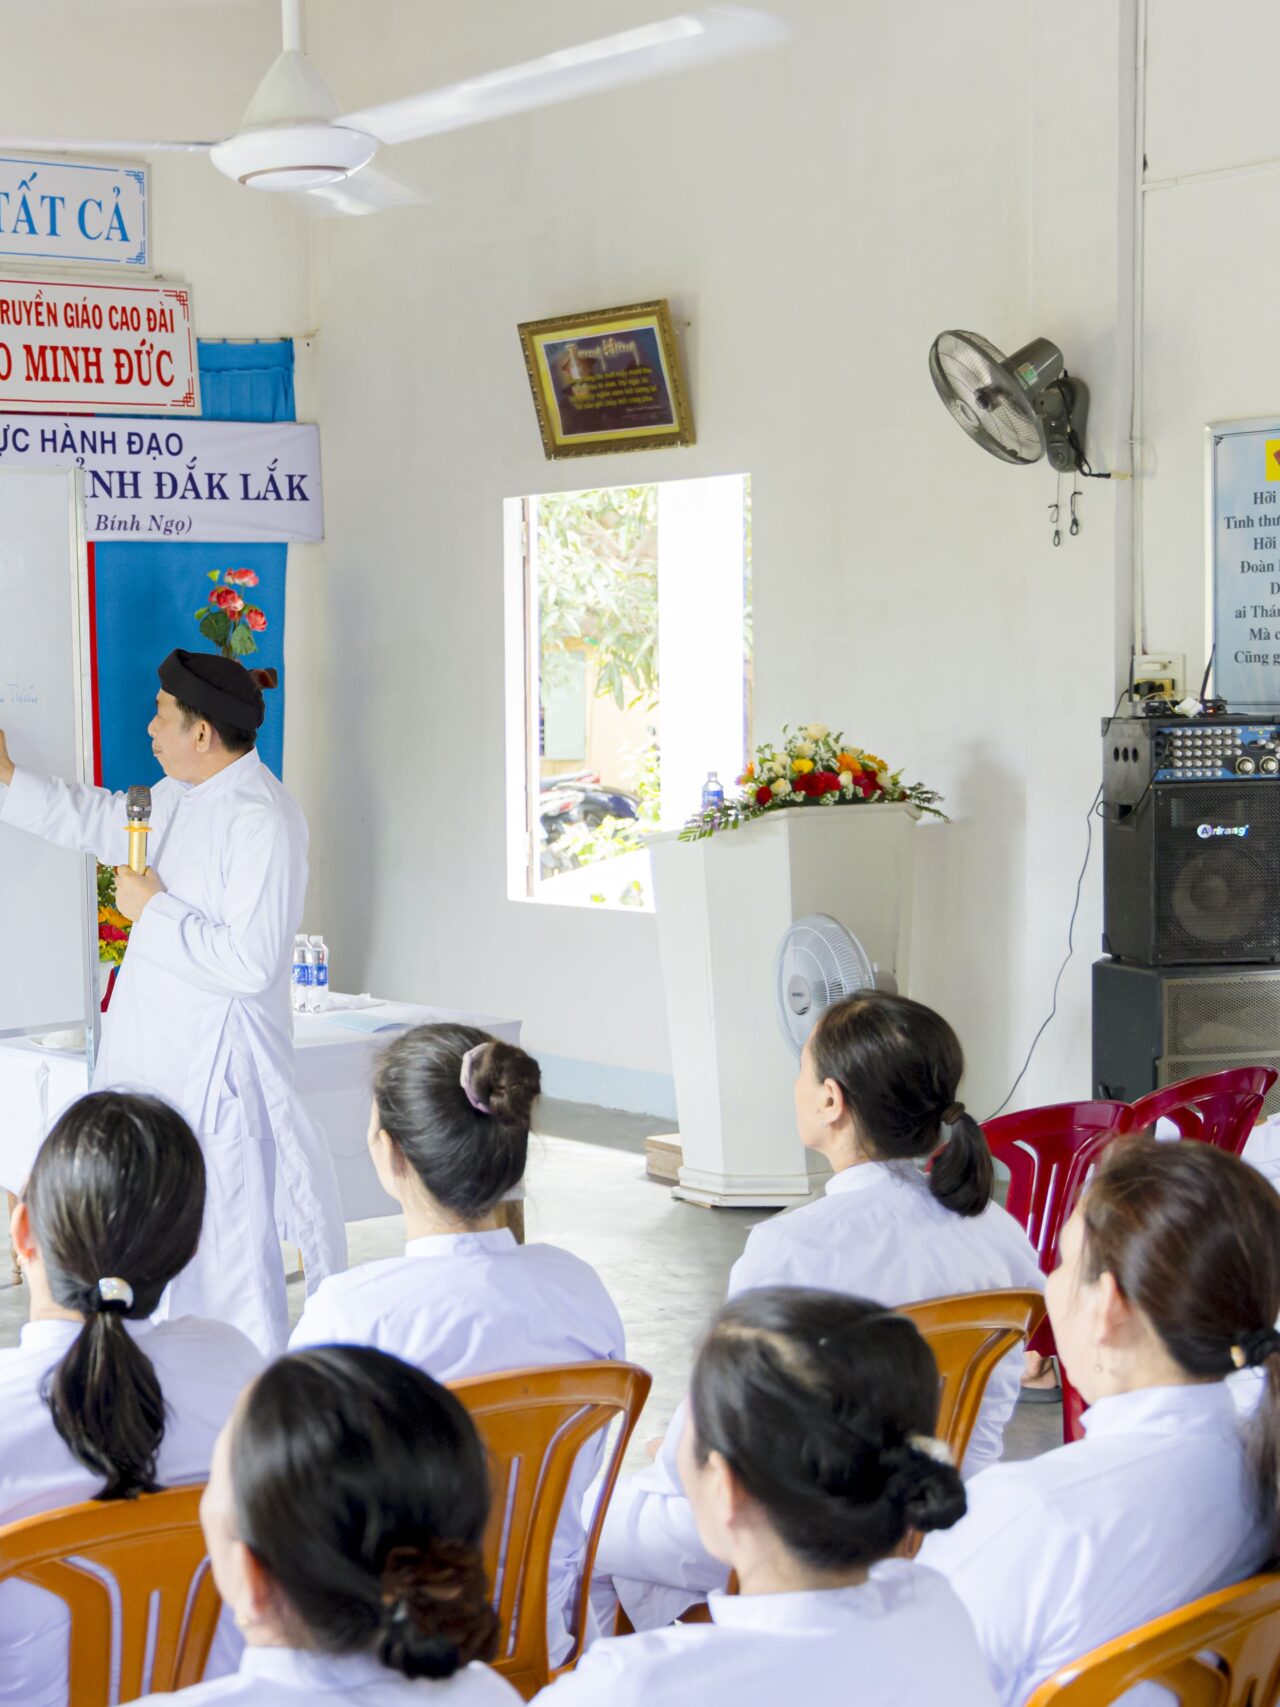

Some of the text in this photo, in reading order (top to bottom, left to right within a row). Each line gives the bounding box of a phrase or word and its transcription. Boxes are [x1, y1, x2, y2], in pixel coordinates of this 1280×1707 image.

[77, 186, 131, 242] CẢ
[63, 297, 103, 330] GIÁO
[108, 305, 141, 332] CAO
[146, 301, 175, 334] ĐÀI
[23, 344, 105, 384] MINH
[113, 338, 175, 387] ĐỨC
[40, 426, 117, 456] HÀNH
[127, 432, 184, 461] ĐẠO
[84, 470, 142, 499] NH
[153, 456, 230, 500] ĐẮK
[239, 458, 310, 501] LẮK
[95, 514, 140, 532] Bính
[148, 514, 193, 536] Ngọ)
[1240, 559, 1274, 574] Đoàn
[1235, 605, 1246, 619] ai
[1249, 627, 1271, 641] Mà
[1234, 650, 1269, 667] Cũng
